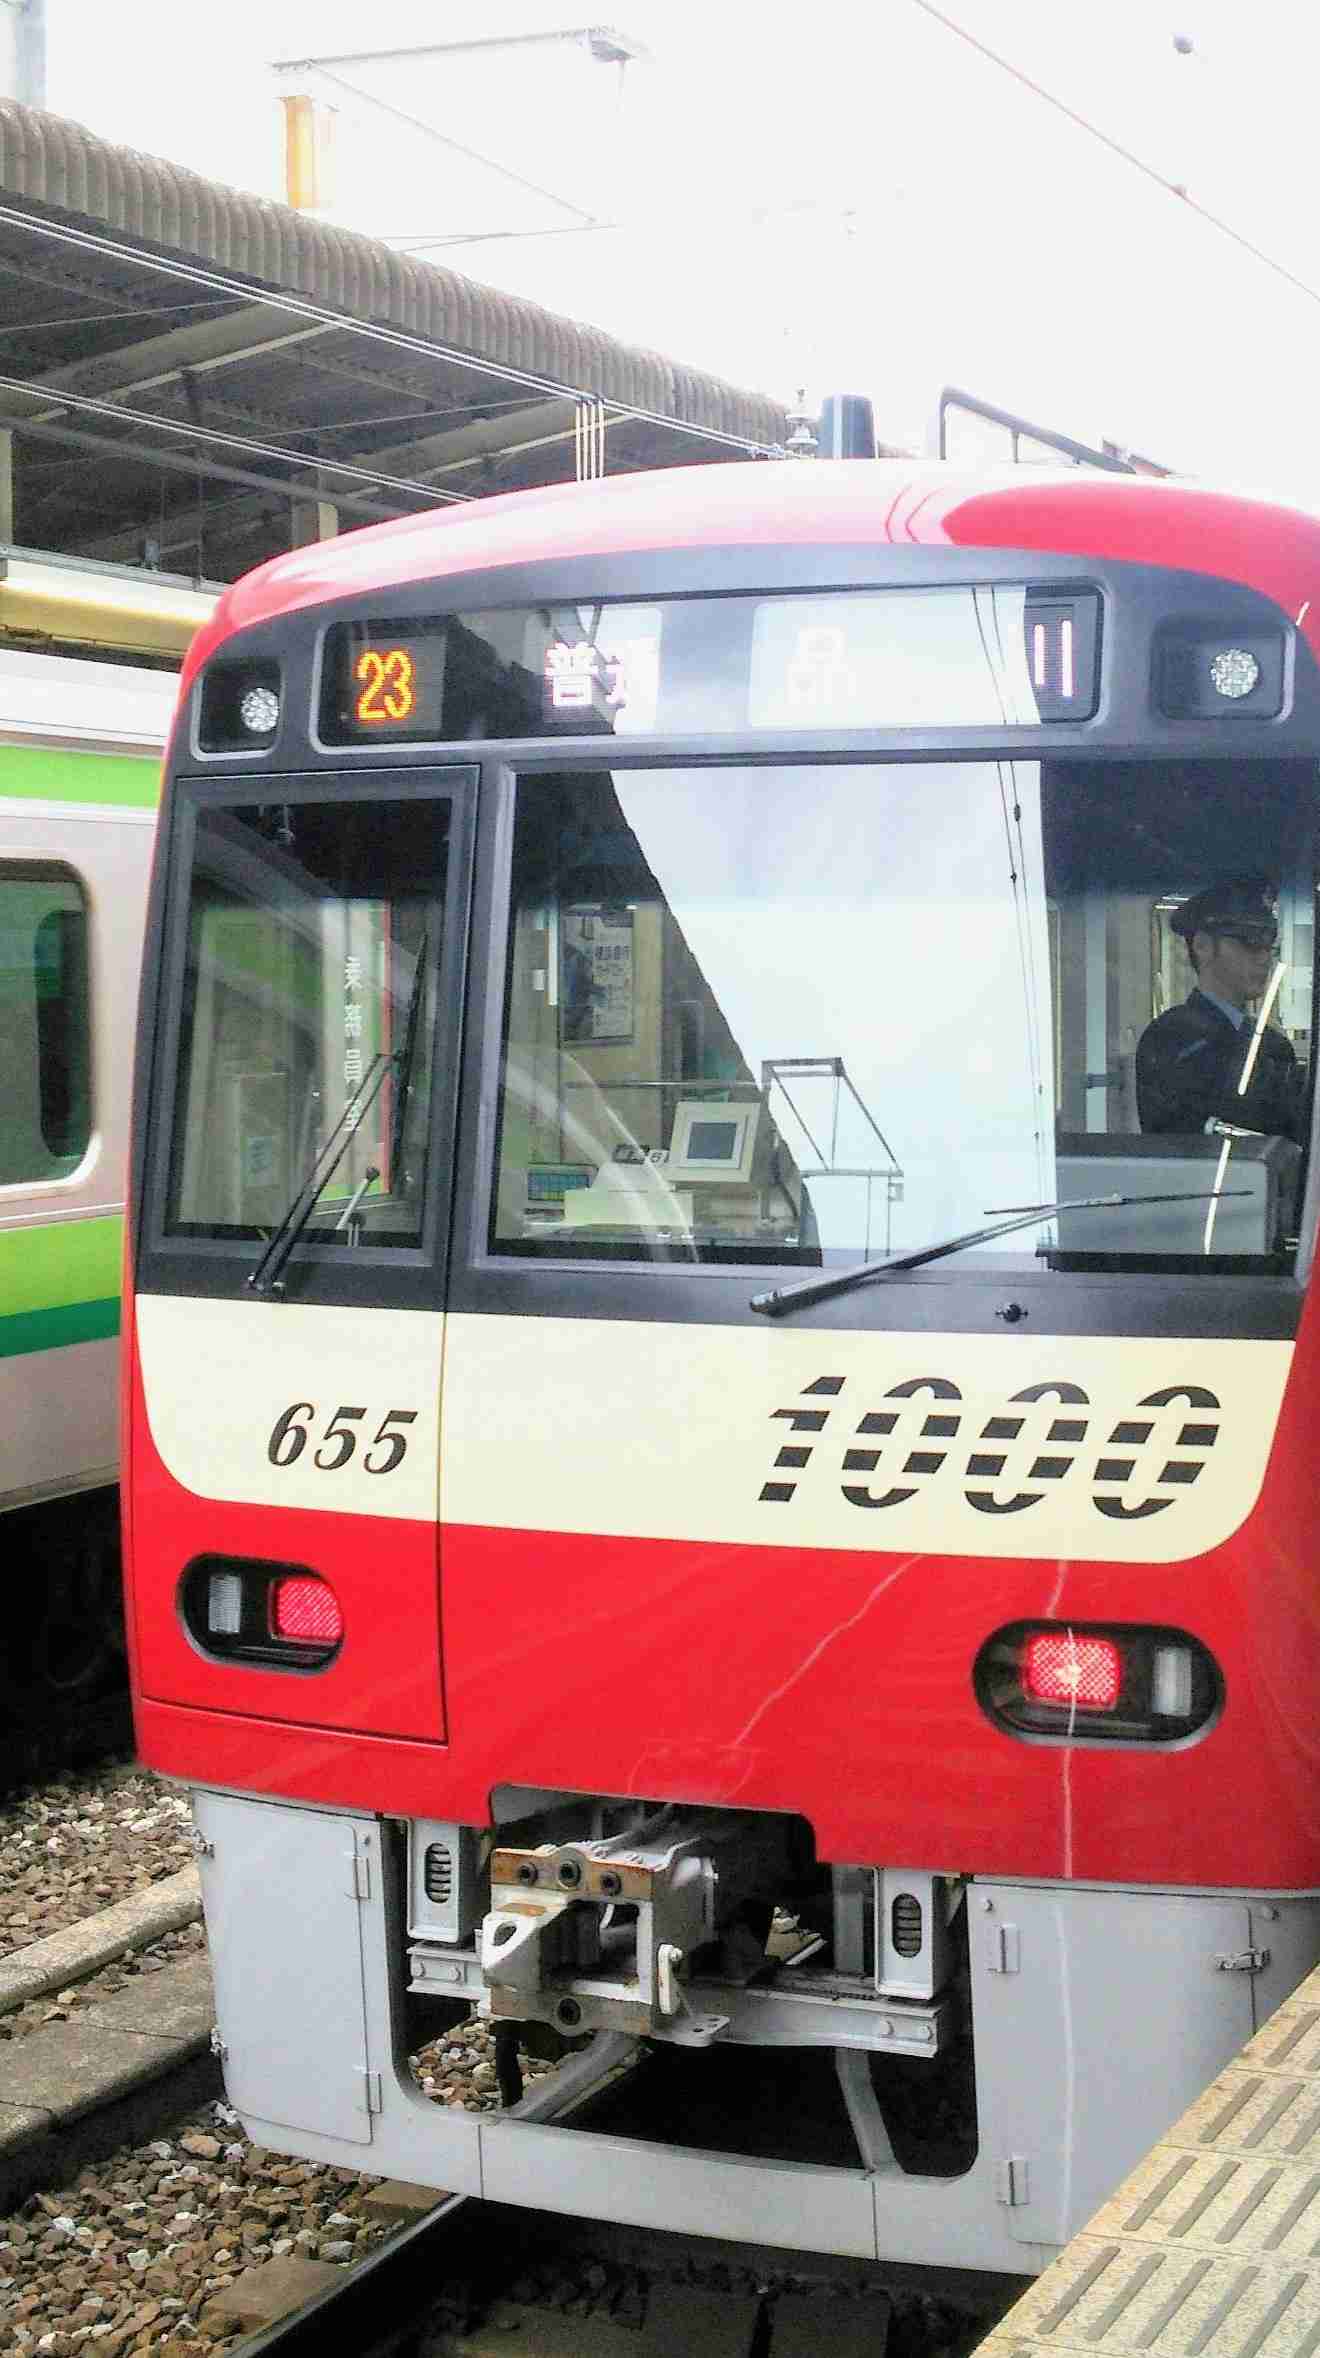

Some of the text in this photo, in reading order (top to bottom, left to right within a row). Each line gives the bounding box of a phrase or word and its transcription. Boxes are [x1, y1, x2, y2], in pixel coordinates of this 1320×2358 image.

[354, 648, 416, 724] 23
[267, 1402, 418, 1475] 655
[757, 1376, 1222, 1520] 1000
